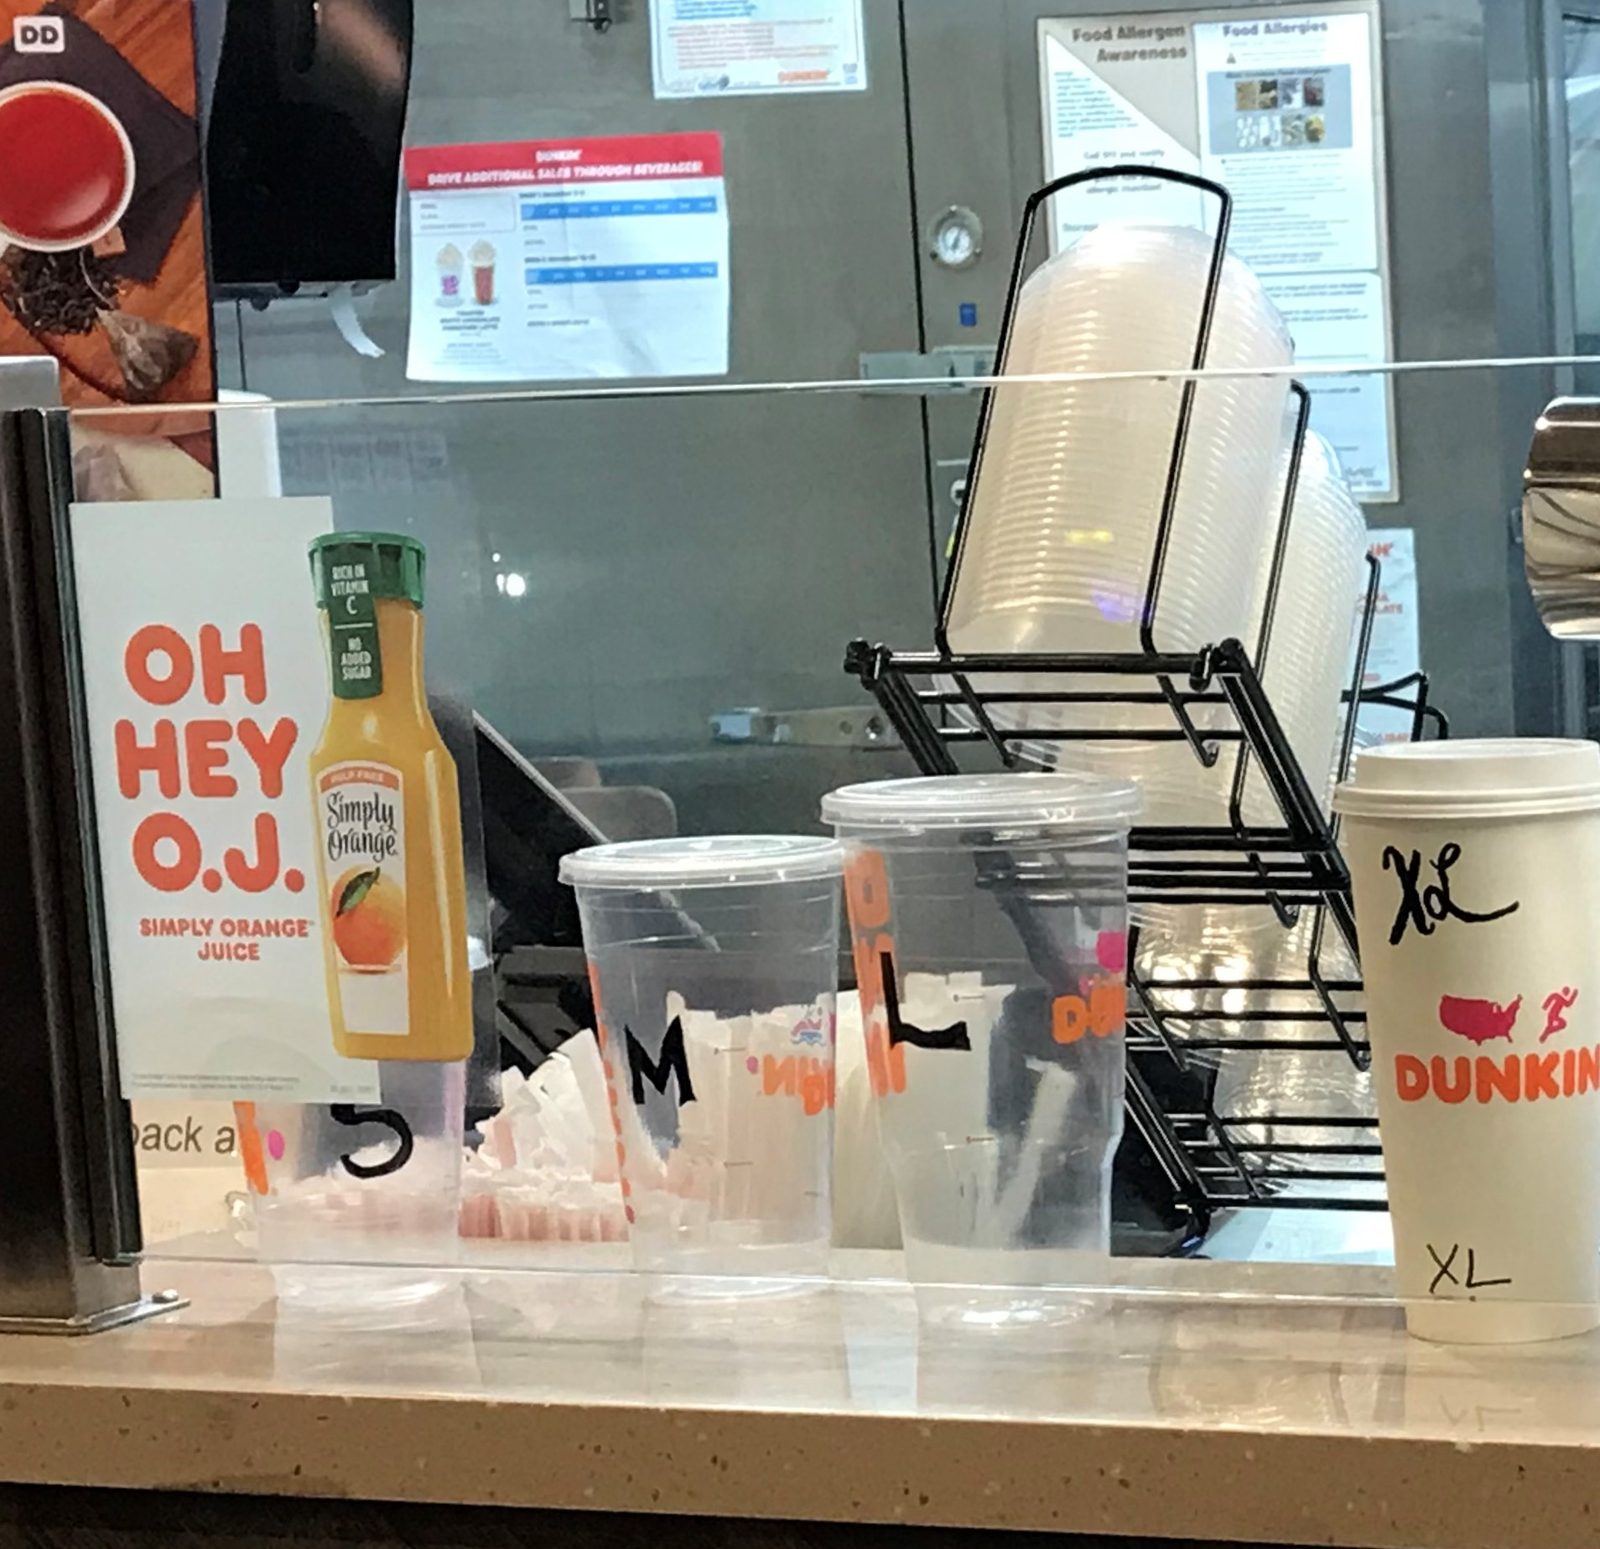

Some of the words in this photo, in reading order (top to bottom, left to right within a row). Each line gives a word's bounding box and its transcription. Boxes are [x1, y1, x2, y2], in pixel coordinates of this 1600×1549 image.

[20, 25, 59, 45] DD
[1072, 27, 1113, 43] Food
[1117, 23, 1186, 42] Allergen
[1223, 23, 1259, 38] Food
[1263, 20, 1329, 37] Allergies
[1097, 46, 1188, 63] Awareness
[427, 171, 463, 186] DRIVE
[464, 168, 536, 184] ADDITIONAL
[537, 165, 572, 180] SALES
[574, 162, 632, 178] THROUGH
[330, 579, 370, 598] VITAMIN
[345, 595, 358, 614] C
[125, 624, 267, 706] OH
[115, 718, 299, 800] HEY
[326, 791, 397, 834] Simply
[132, 812, 305, 893] O.J.
[327, 826, 397, 863] Orange
[139, 918, 214, 938] SIMPLY
[197, 942, 261, 962] JUICE
[882, 952, 972, 1052] L
[625, 1014, 697, 1106] M
[1394, 1043, 1600, 1105] DUNKIN
[1426, 1243, 1513, 1293] XL
